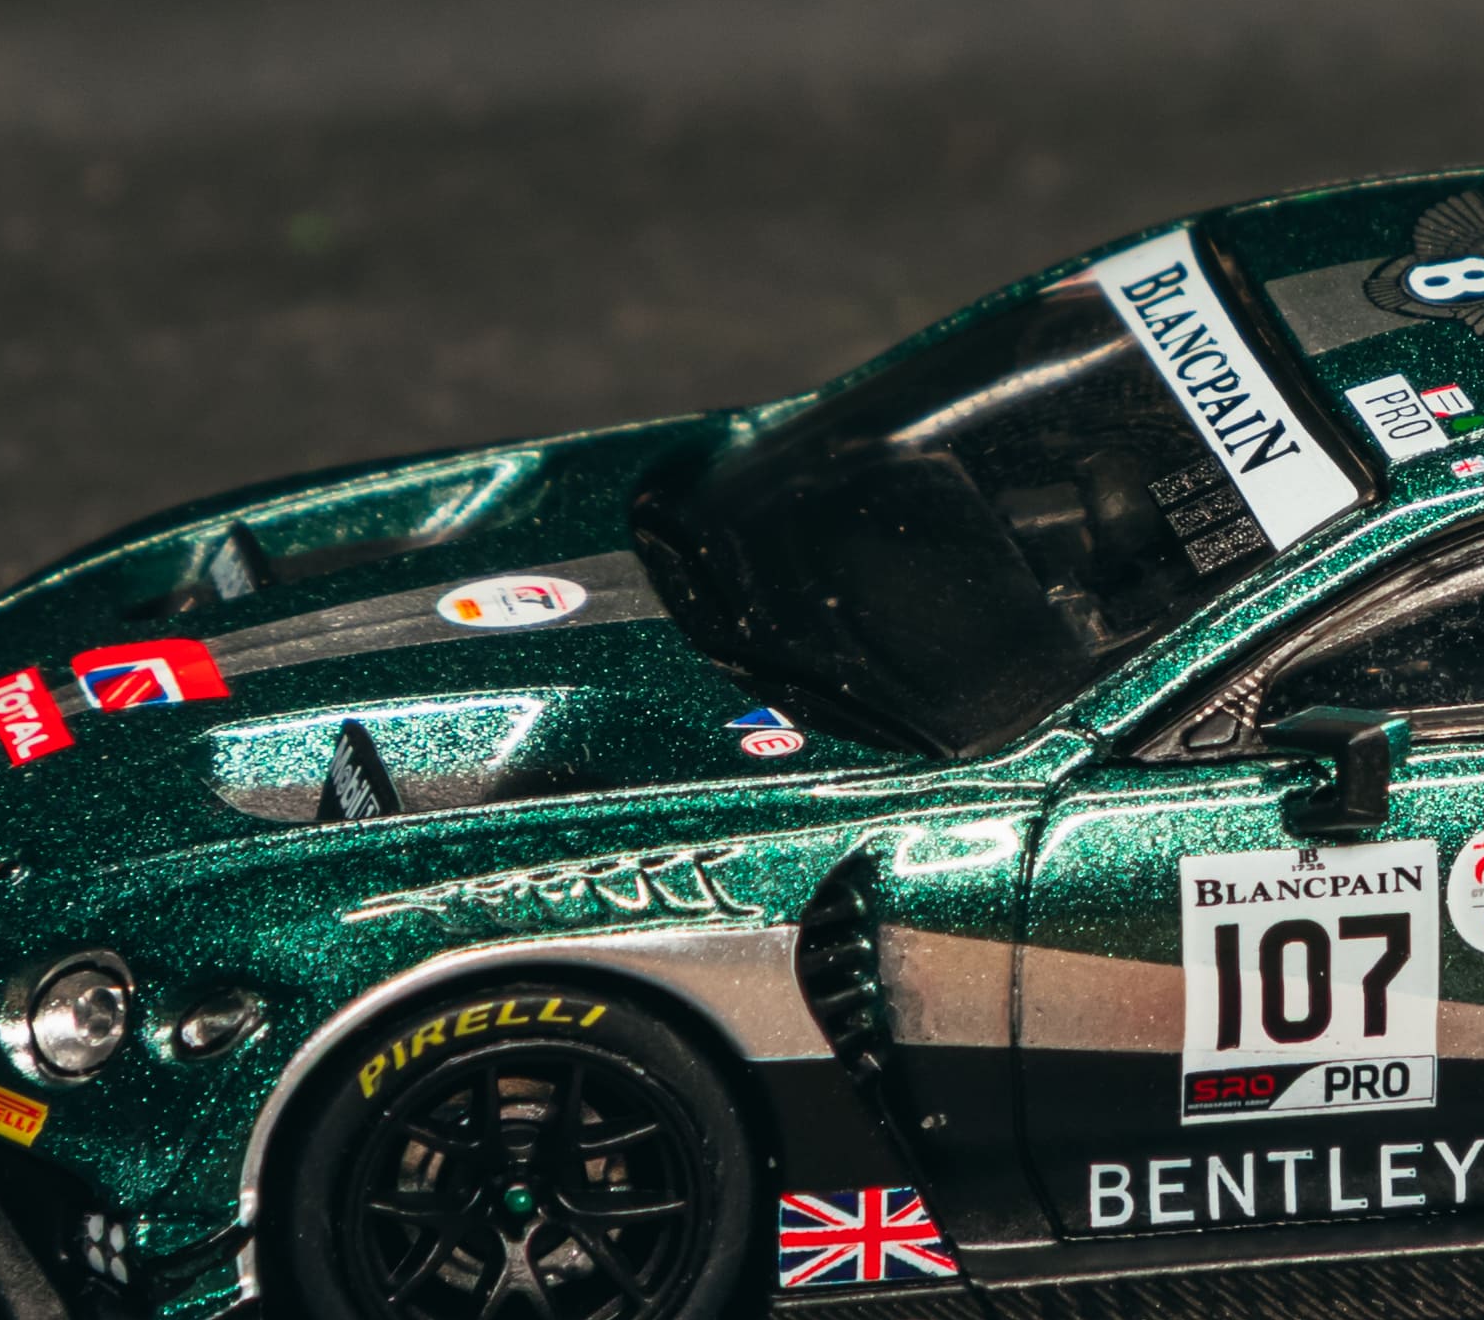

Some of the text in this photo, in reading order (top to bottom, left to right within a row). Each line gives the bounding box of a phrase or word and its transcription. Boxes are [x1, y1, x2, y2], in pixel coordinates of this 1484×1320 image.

[1120, 260, 1301, 474] BLANCPAIN
[1365, 389, 1432, 439] PRO
[1194, 865, 1424, 907] BLANCPAIN
[1215, 912, 1411, 1052] 107
[358, 997, 607, 1099] PIRELLI
[1193, 1061, 1411, 1103] SRO PRO
